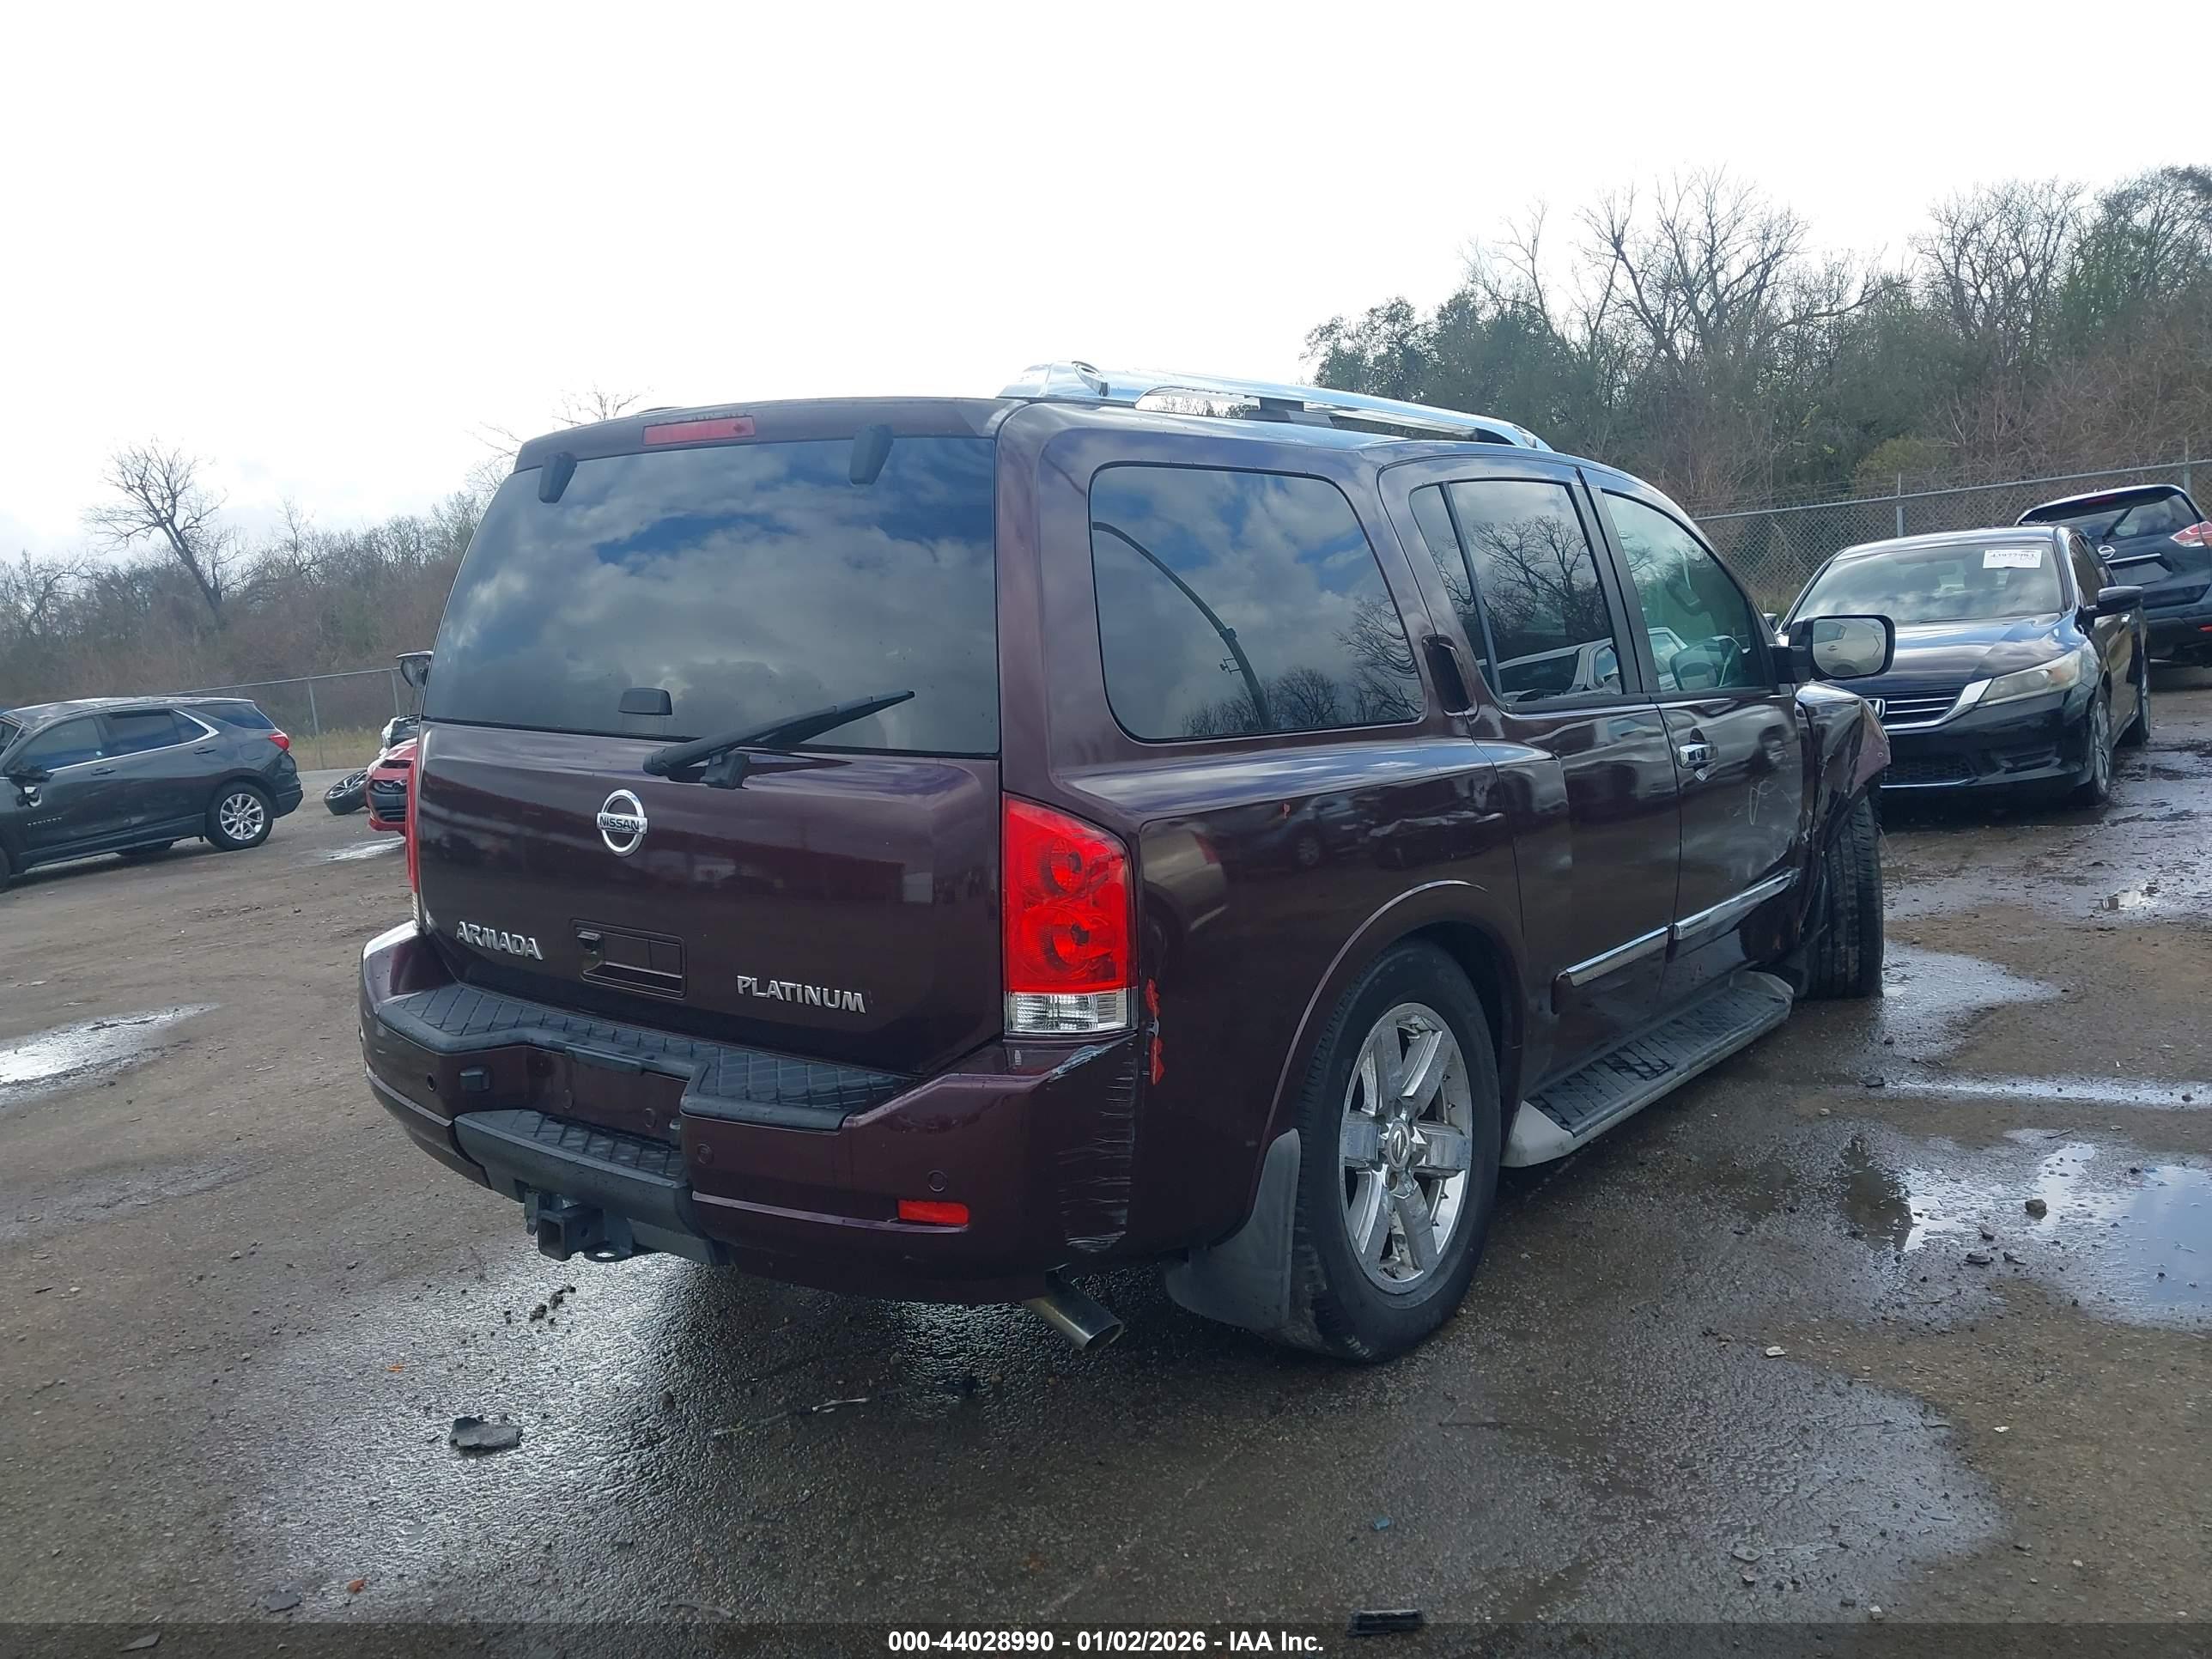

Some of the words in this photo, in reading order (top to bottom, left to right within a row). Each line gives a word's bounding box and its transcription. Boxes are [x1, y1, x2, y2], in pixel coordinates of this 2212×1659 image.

[599, 816, 640, 831] NISSAN
[456, 921, 544, 961] ARMADA
[737, 975, 866, 1014] PLATINUM
